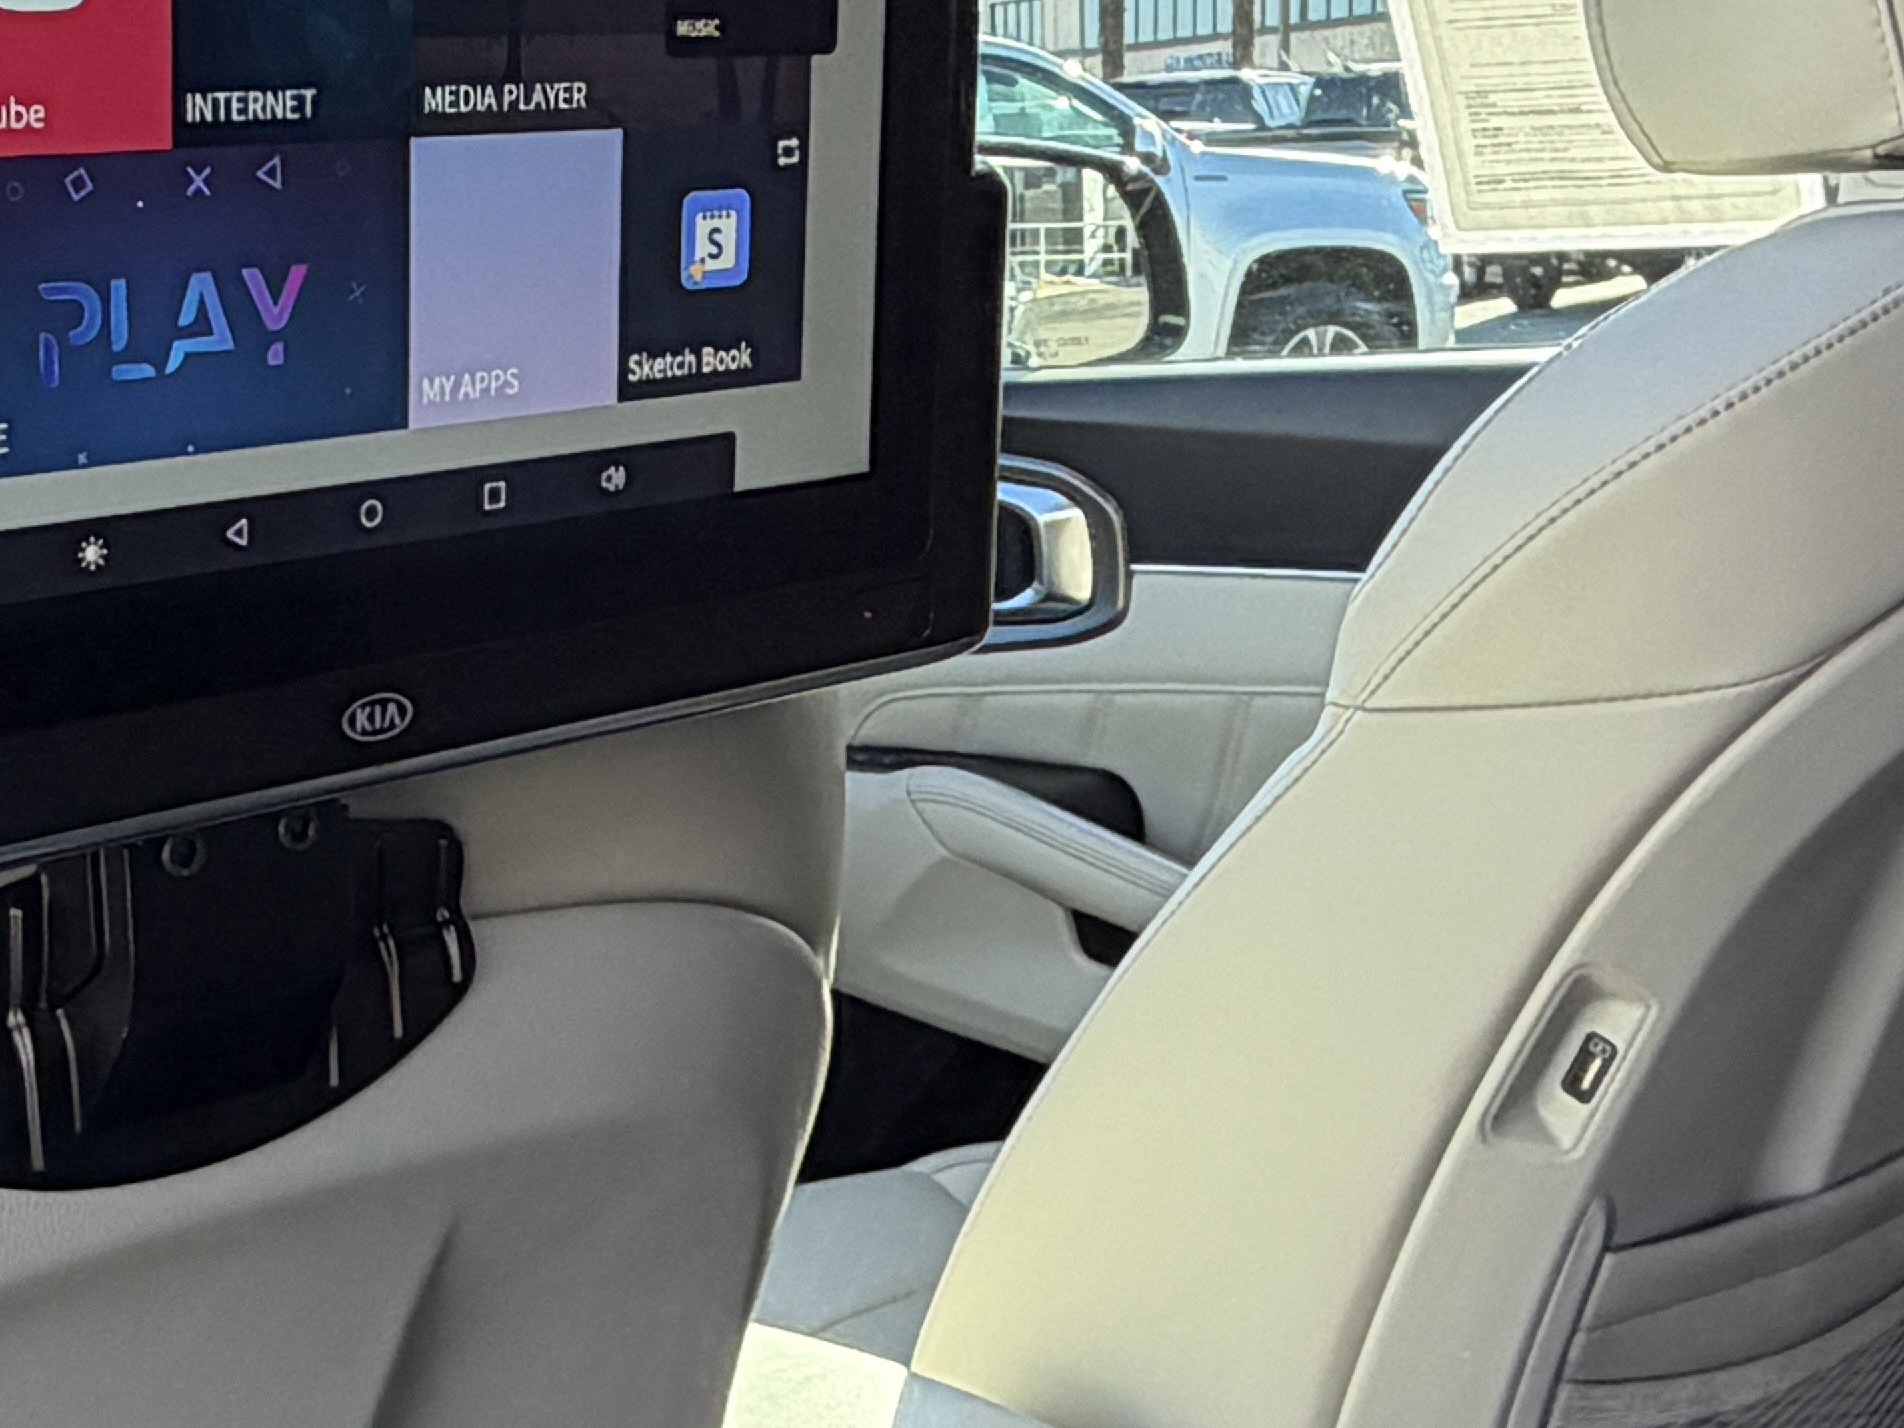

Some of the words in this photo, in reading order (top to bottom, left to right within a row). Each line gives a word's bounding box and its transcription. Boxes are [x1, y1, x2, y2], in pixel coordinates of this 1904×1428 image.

[185, 87, 317, 123] INTERNET
[423, 83, 498, 114] MEDIA
[501, 80, 587, 112] PLAYER
[38, 263, 309, 388] PLAY
[627, 347, 697, 382] Sketch
[700, 339, 752, 374] Book
[421, 373, 455, 405] MY
[457, 366, 520, 401] APPS
[354, 701, 403, 734] KIA
